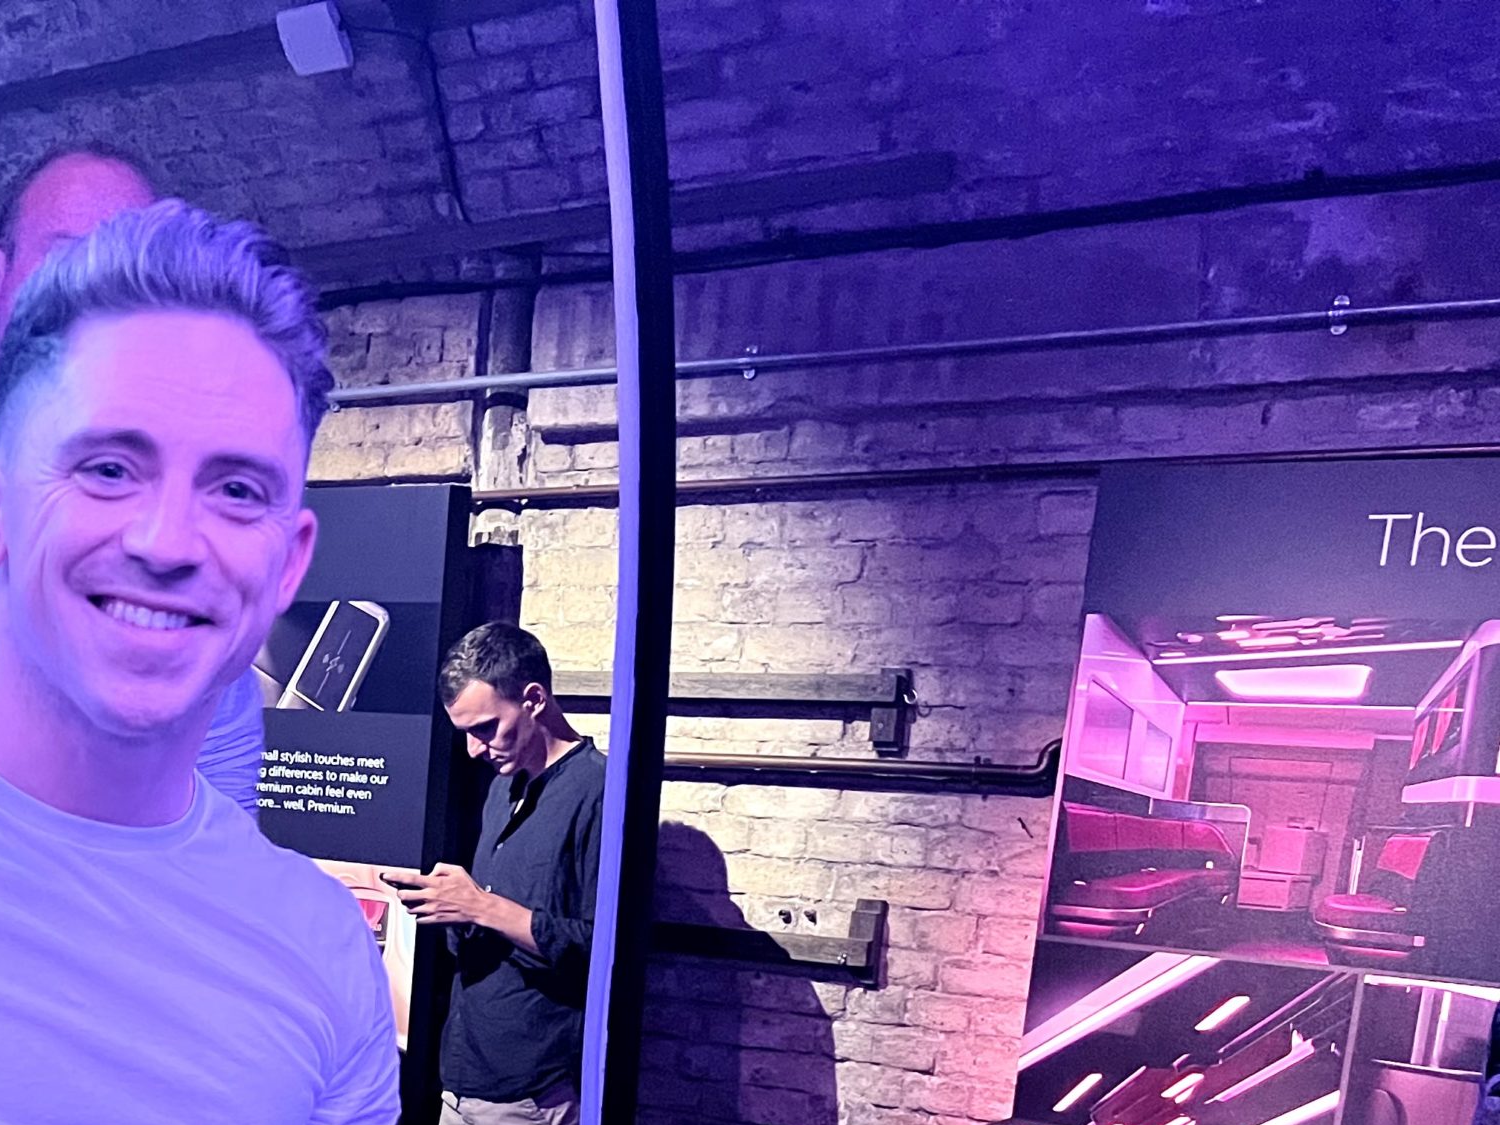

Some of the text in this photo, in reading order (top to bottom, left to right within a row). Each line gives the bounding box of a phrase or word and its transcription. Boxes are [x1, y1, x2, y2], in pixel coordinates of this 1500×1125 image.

[1368, 512, 1497, 567] The
[260, 750, 385, 768] mall stylish touches meet
[268, 766, 323, 779] differences
[326, 771, 337, 781] to
[339, 772, 368, 783] make
[370, 774, 388, 785] our
[256, 782, 372, 799] remium cabin feel even
[284, 799, 305, 812] well,
[308, 800, 355, 814] Premium.
